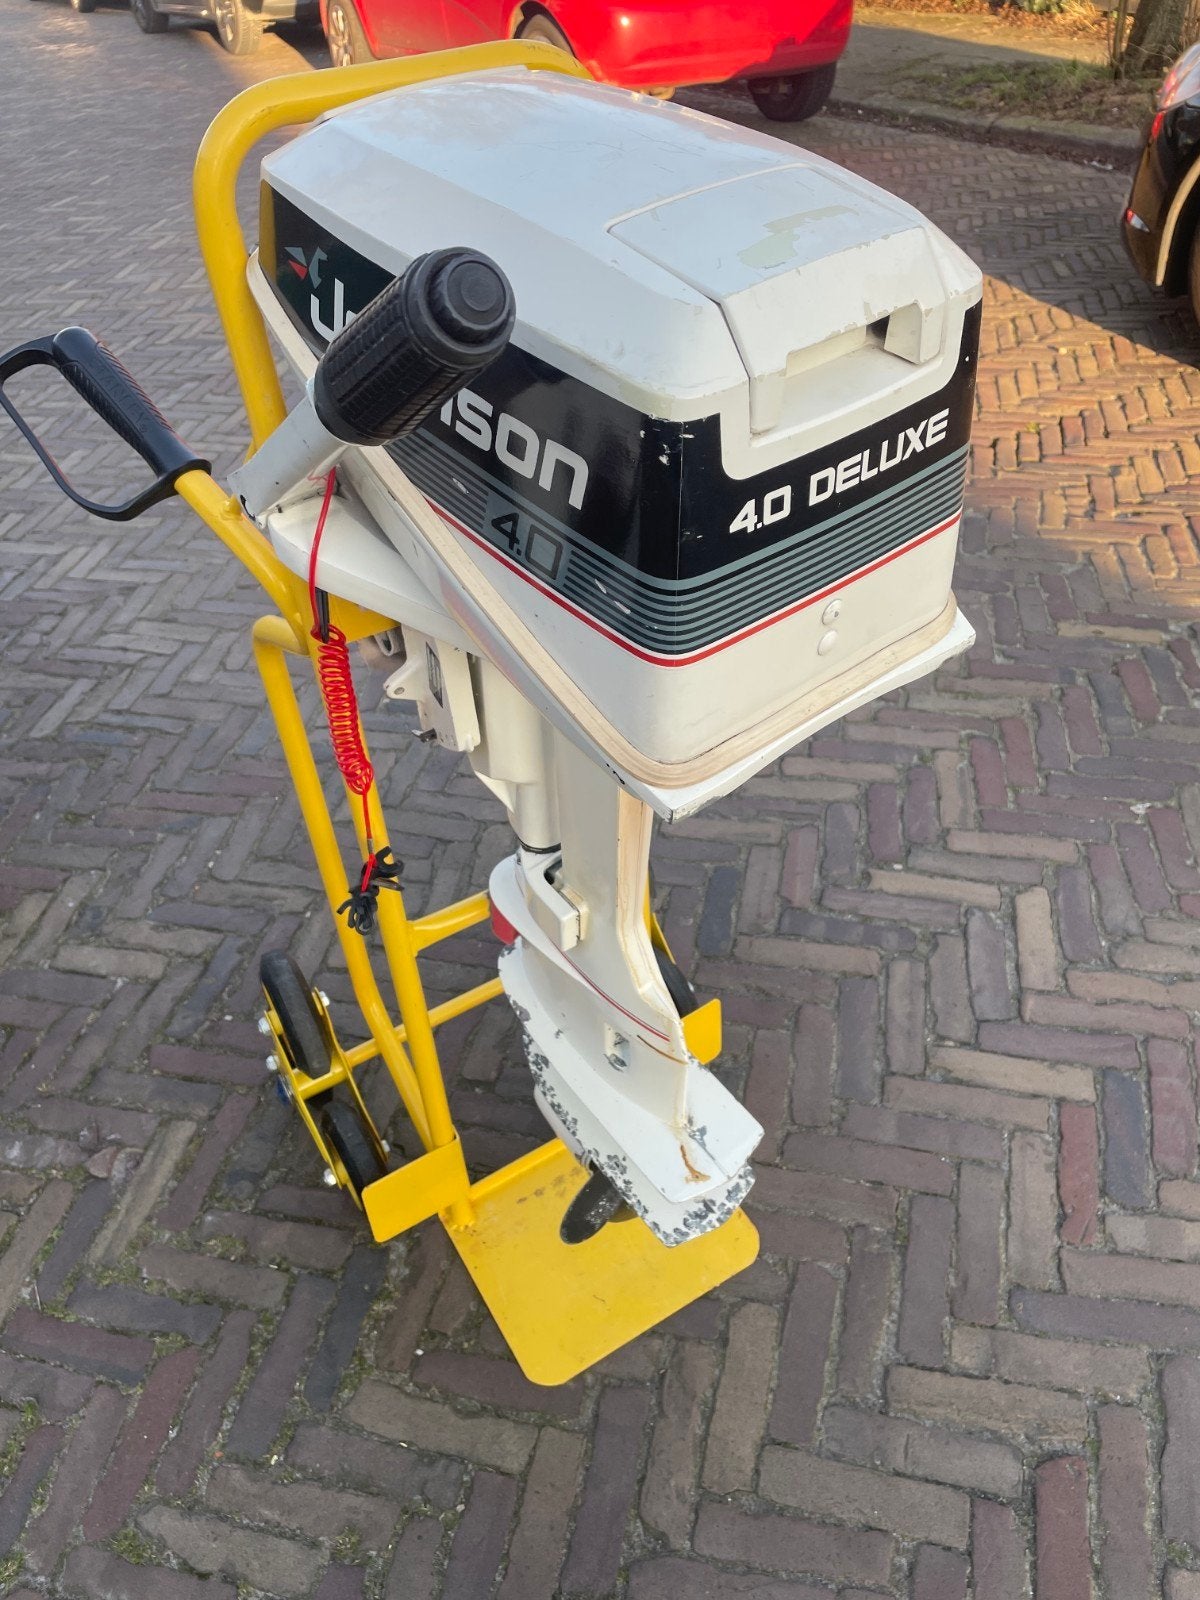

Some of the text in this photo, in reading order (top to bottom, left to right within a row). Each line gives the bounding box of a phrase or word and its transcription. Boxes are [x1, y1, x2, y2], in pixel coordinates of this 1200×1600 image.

[729, 408, 950, 534] 4.0 DELUXE
[490, 512, 564, 581] 4.0
